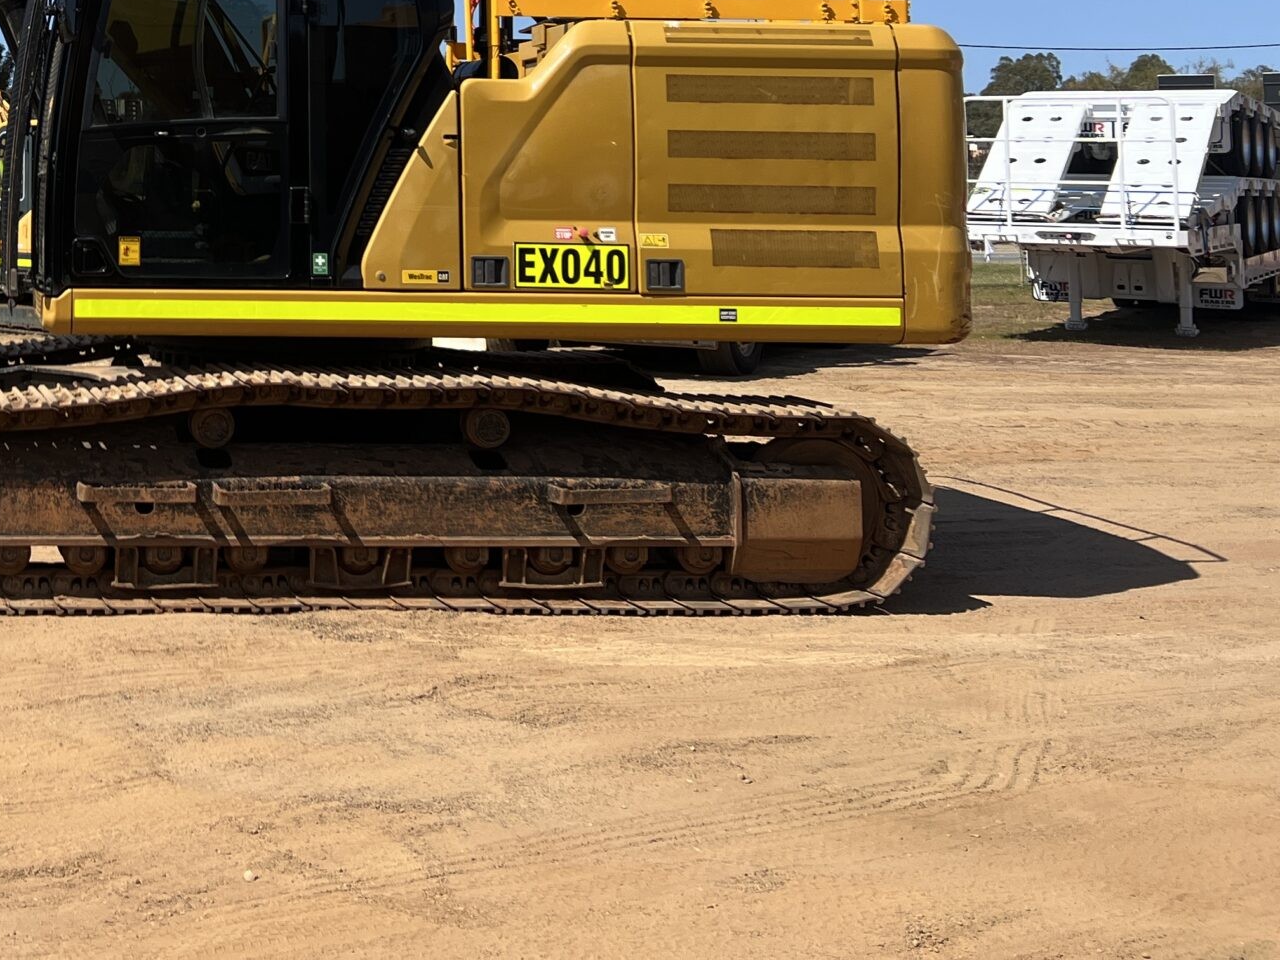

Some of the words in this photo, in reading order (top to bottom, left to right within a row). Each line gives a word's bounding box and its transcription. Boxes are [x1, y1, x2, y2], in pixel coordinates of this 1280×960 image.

[555, 231, 573, 240] STOP
[518, 247, 626, 285] EX040
[1200, 288, 1236, 299] FWR
